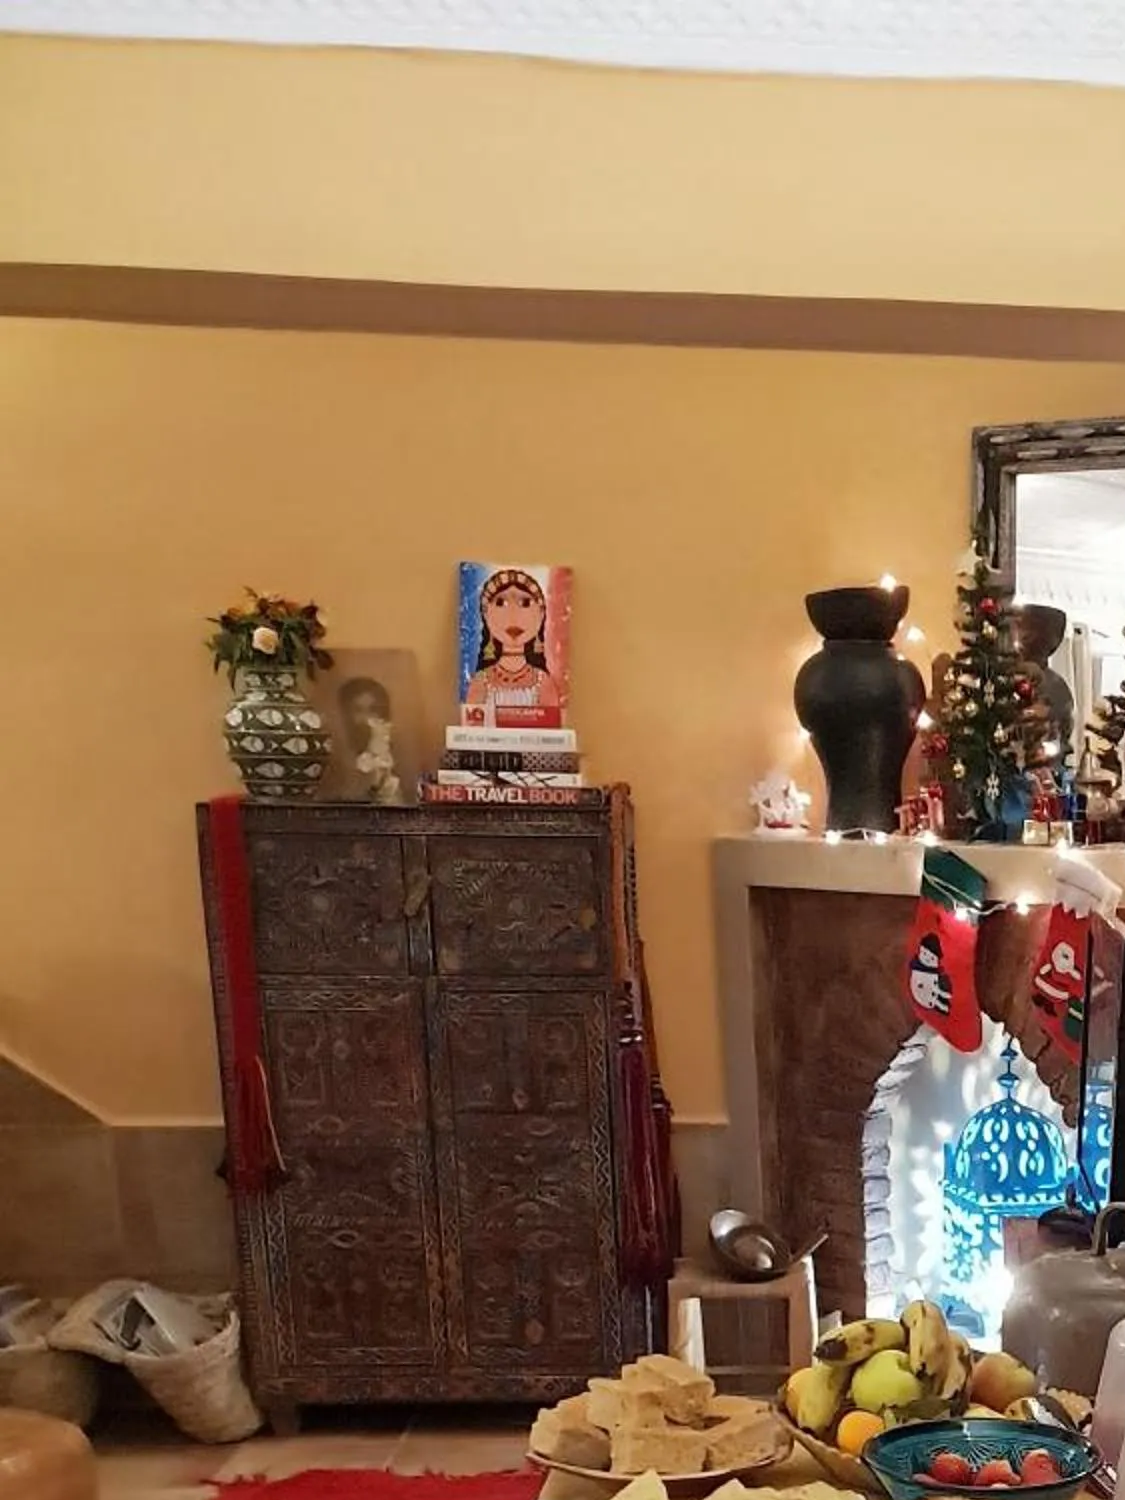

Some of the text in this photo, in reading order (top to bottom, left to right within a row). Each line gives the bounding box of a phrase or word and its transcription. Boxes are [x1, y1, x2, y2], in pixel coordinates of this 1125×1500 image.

[429, 786, 577, 804] THE TRAVEL BOOK
